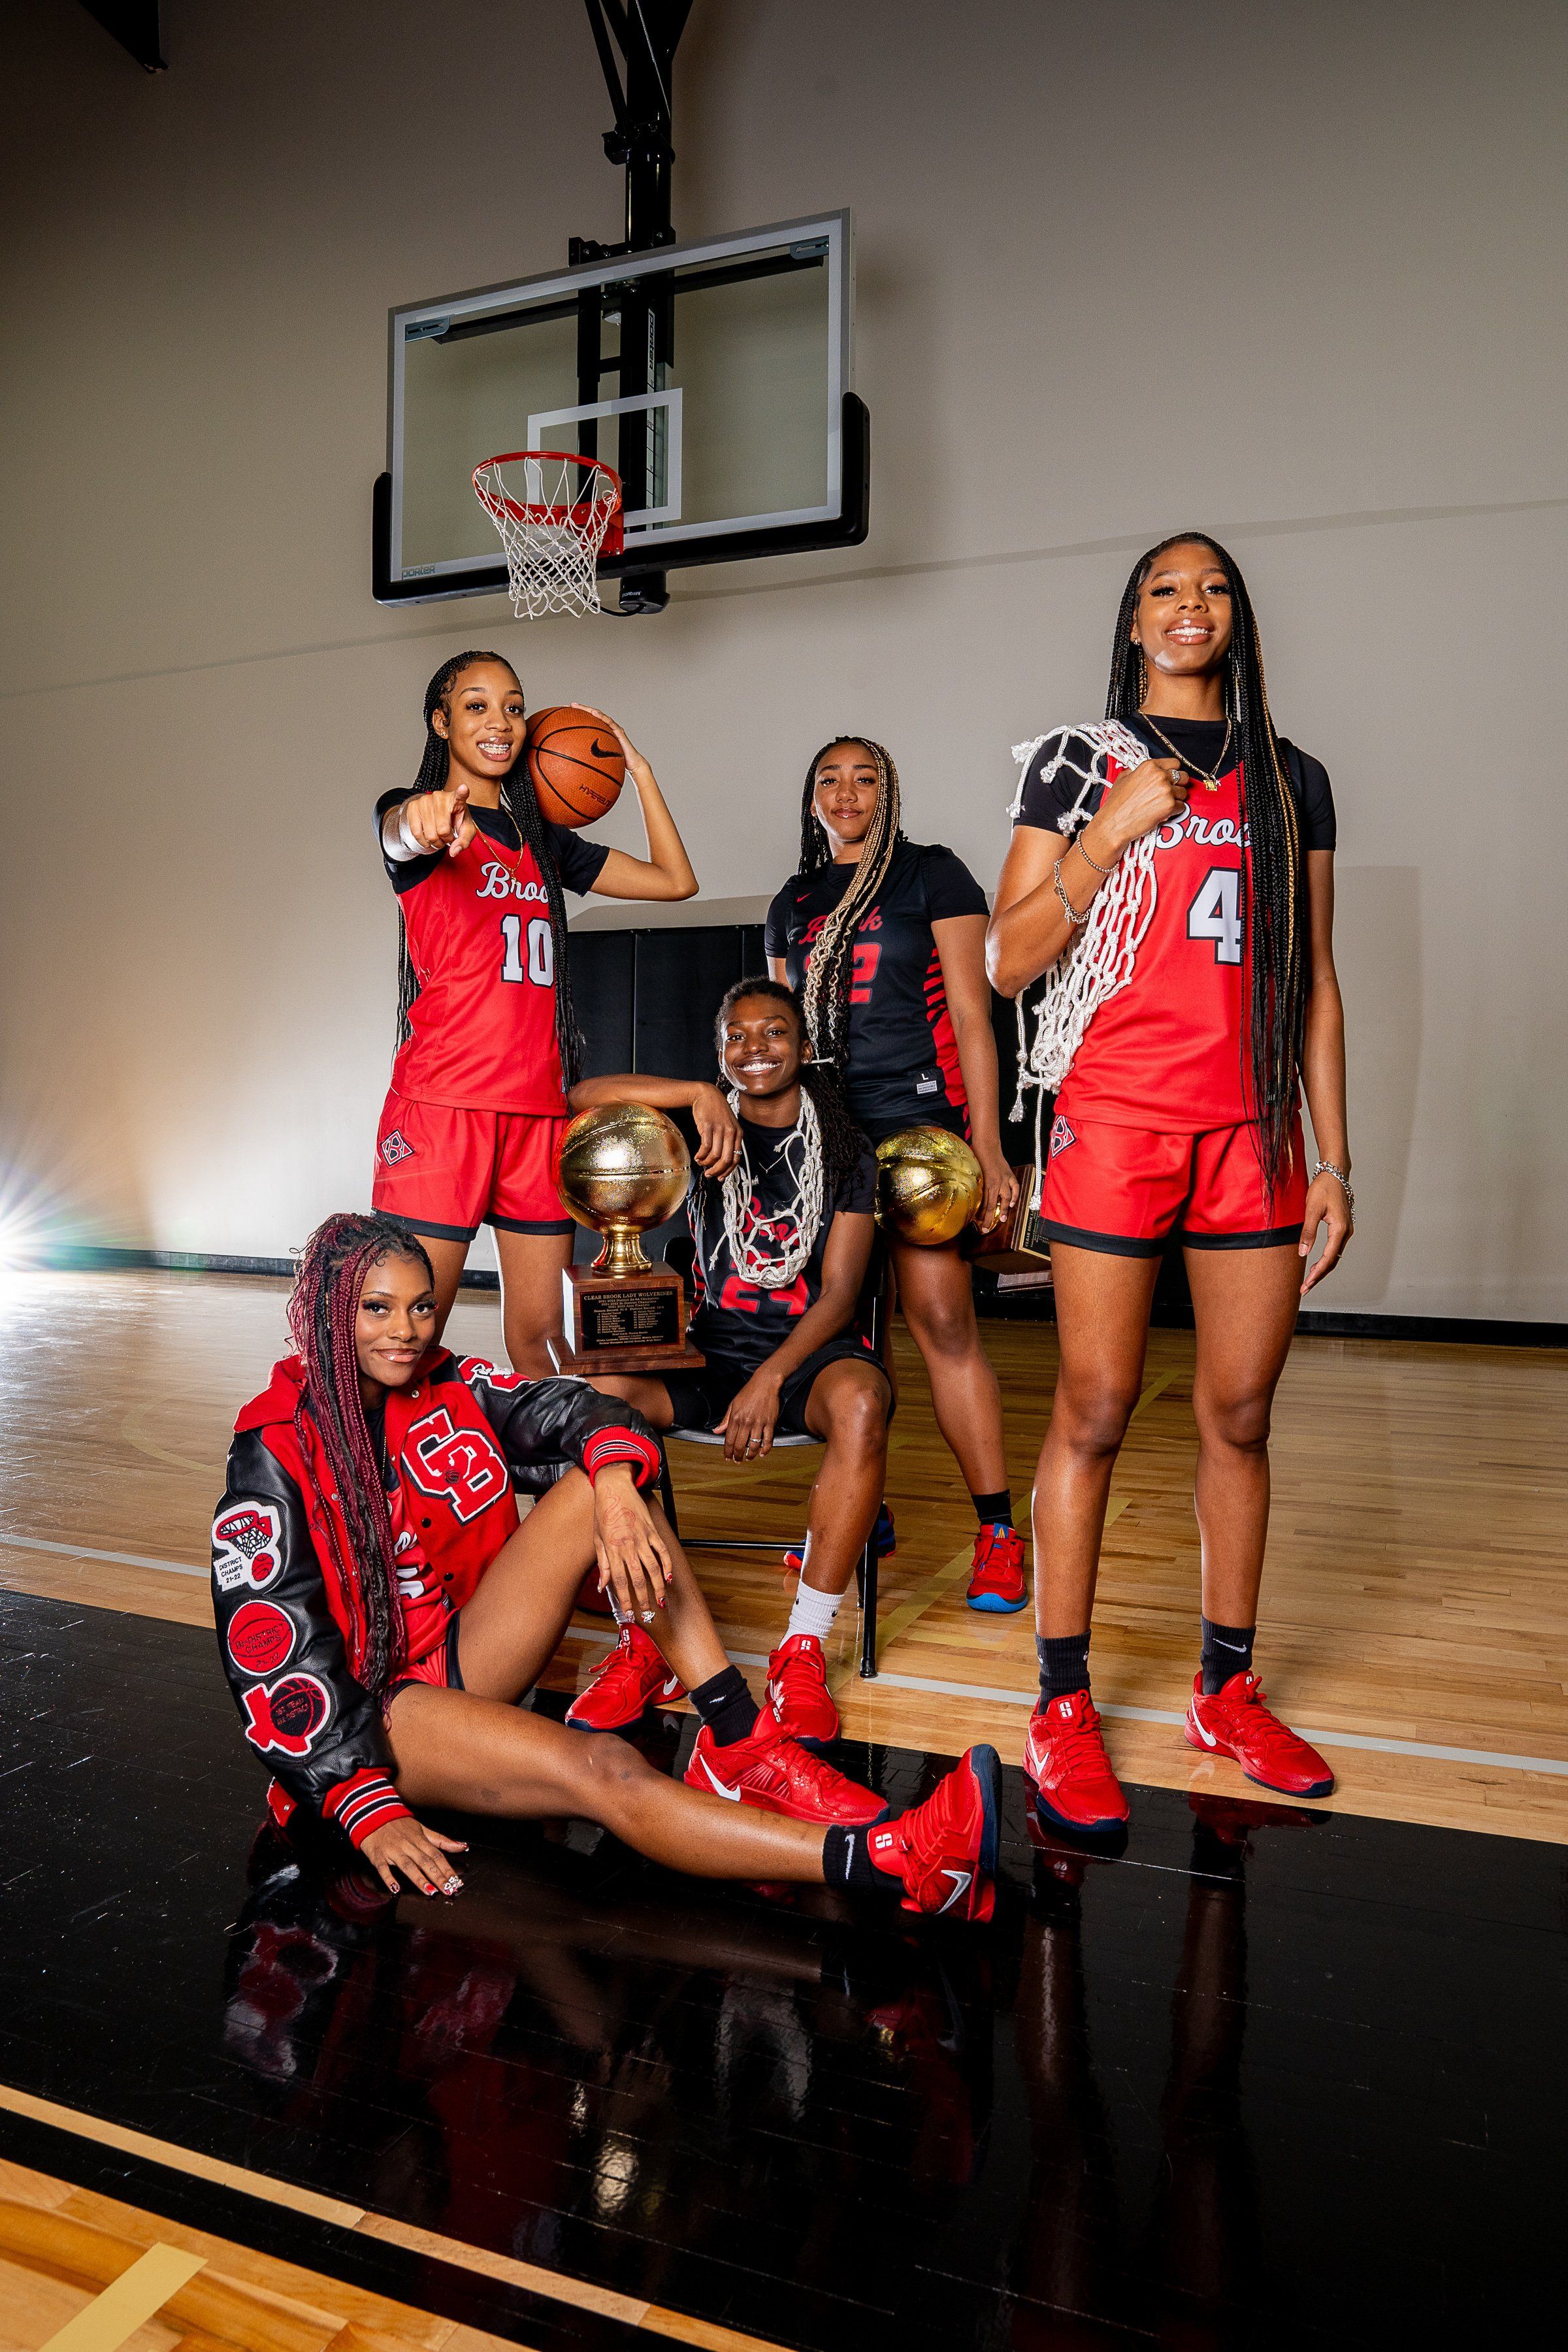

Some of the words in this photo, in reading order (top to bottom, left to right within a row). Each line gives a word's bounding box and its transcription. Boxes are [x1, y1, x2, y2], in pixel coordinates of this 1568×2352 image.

[1186, 866, 1243, 967] 4
[500, 913, 555, 989] 10
[400, 1403, 510, 1527] CB
[219, 1556, 242, 1571] DISTRICT
[221, 1564, 243, 1576] CHAMPS
[226, 1573, 240, 1583] 21-22
[246, 1634, 281, 1654] CHAMPS
